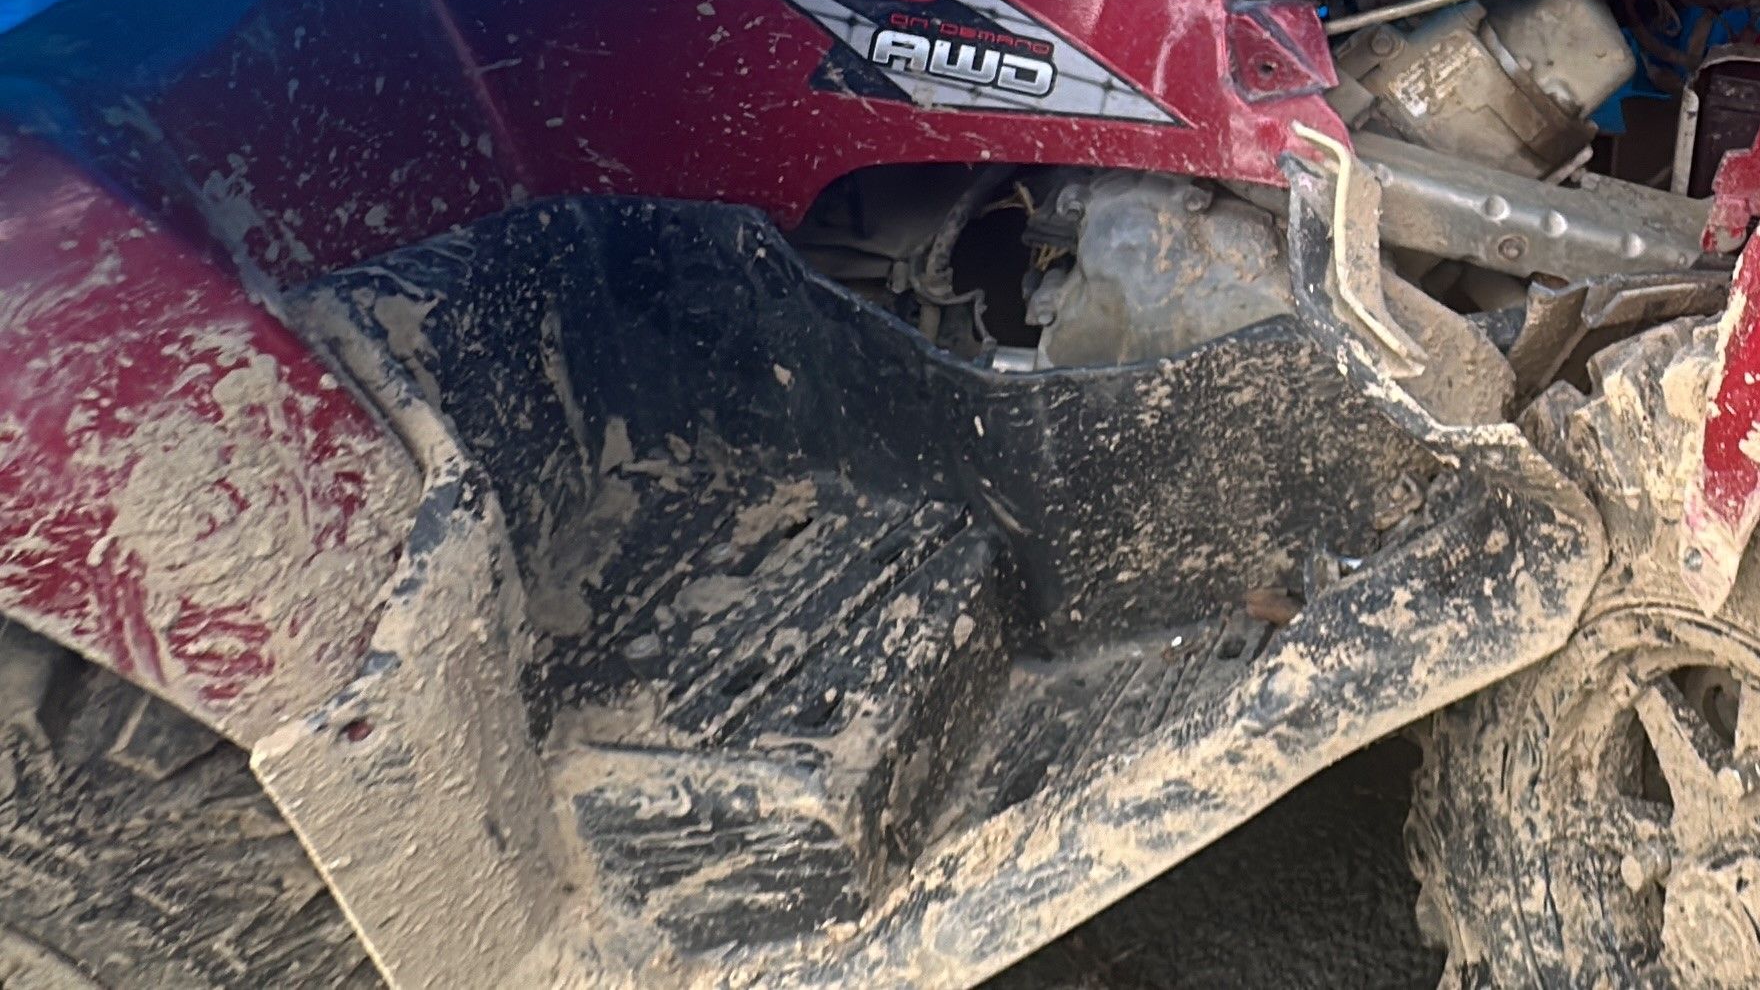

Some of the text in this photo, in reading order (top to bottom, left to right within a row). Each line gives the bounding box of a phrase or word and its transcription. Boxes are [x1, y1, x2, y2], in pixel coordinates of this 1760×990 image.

[890, 12, 1050, 56] ON DEMAND
[872, 29, 1054, 96] AWD
